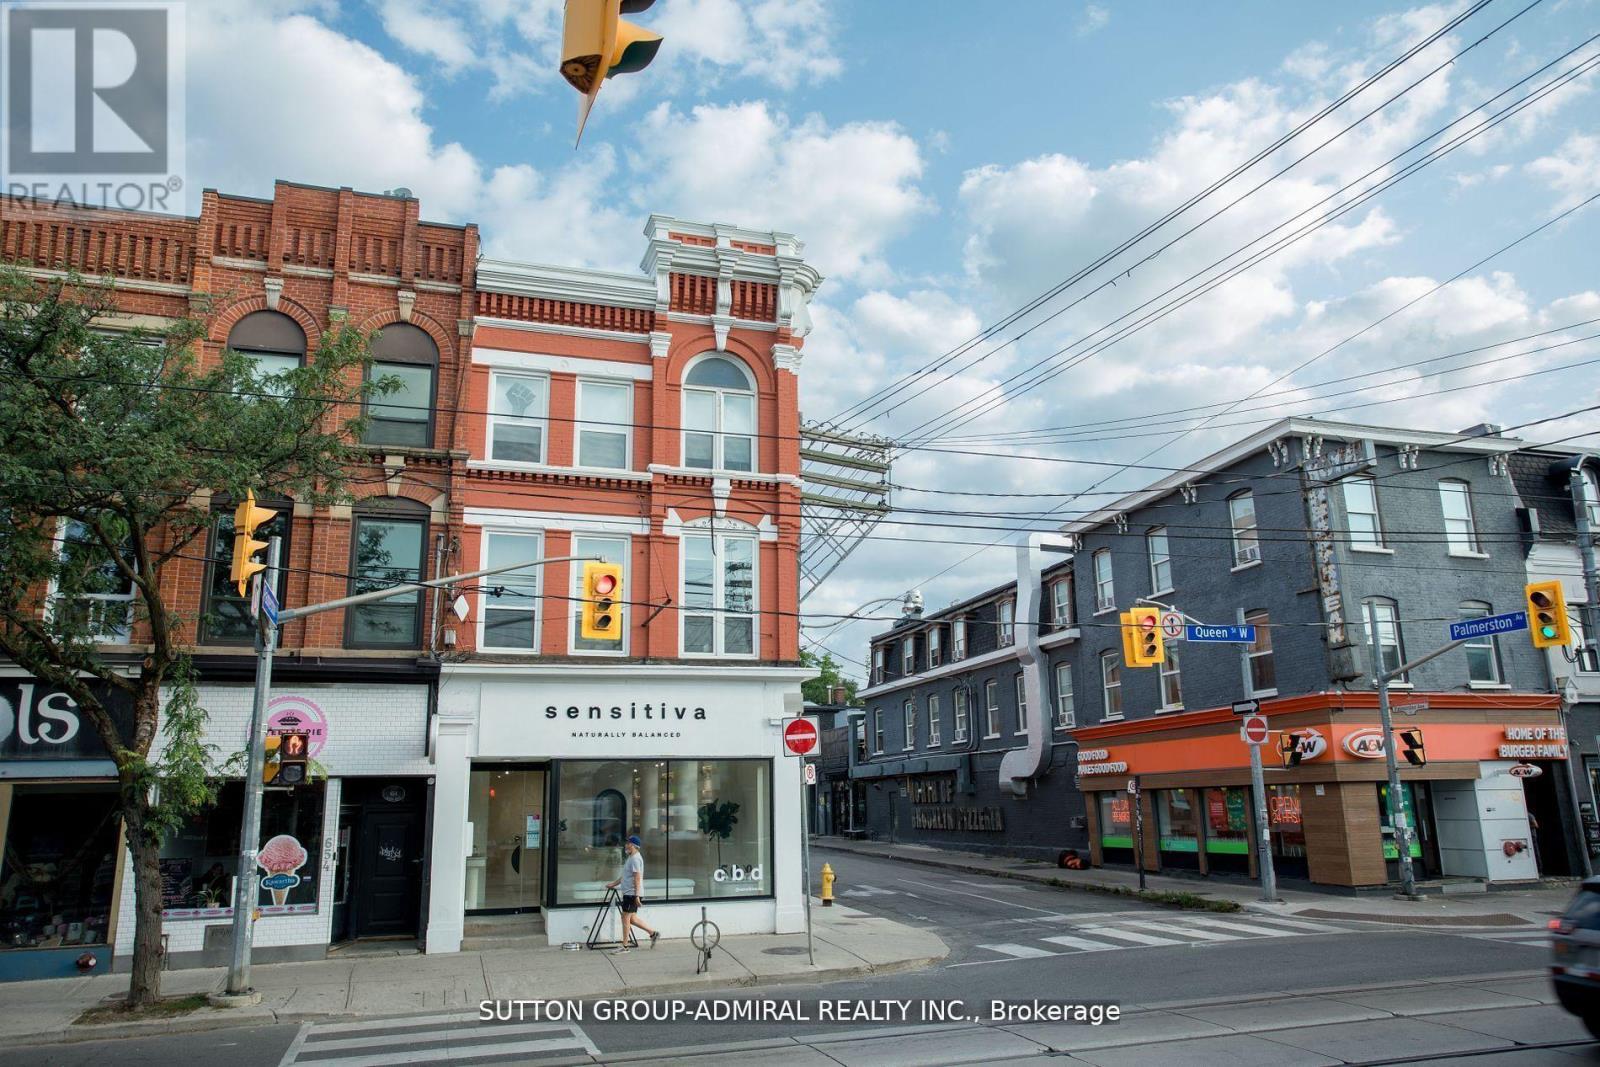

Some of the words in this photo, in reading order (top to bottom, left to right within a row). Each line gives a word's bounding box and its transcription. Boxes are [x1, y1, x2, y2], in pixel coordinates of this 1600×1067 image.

[1195, 626, 1228, 639] Queen
[1239, 627, 1248, 639] W
[1453, 618, 1513, 637] Palmerston
[545, 702, 707, 720] sensitiva
[1507, 727, 1533, 740] HOME
[1535, 727, 1547, 740] OF
[1548, 727, 1566, 740] THE
[1091, 749, 1108, 760] FOOD
[1500, 744, 1537, 758] BURGER
[1537, 744, 1568, 758] FAMILY
[1109, 761, 1128, 772] FOOD
